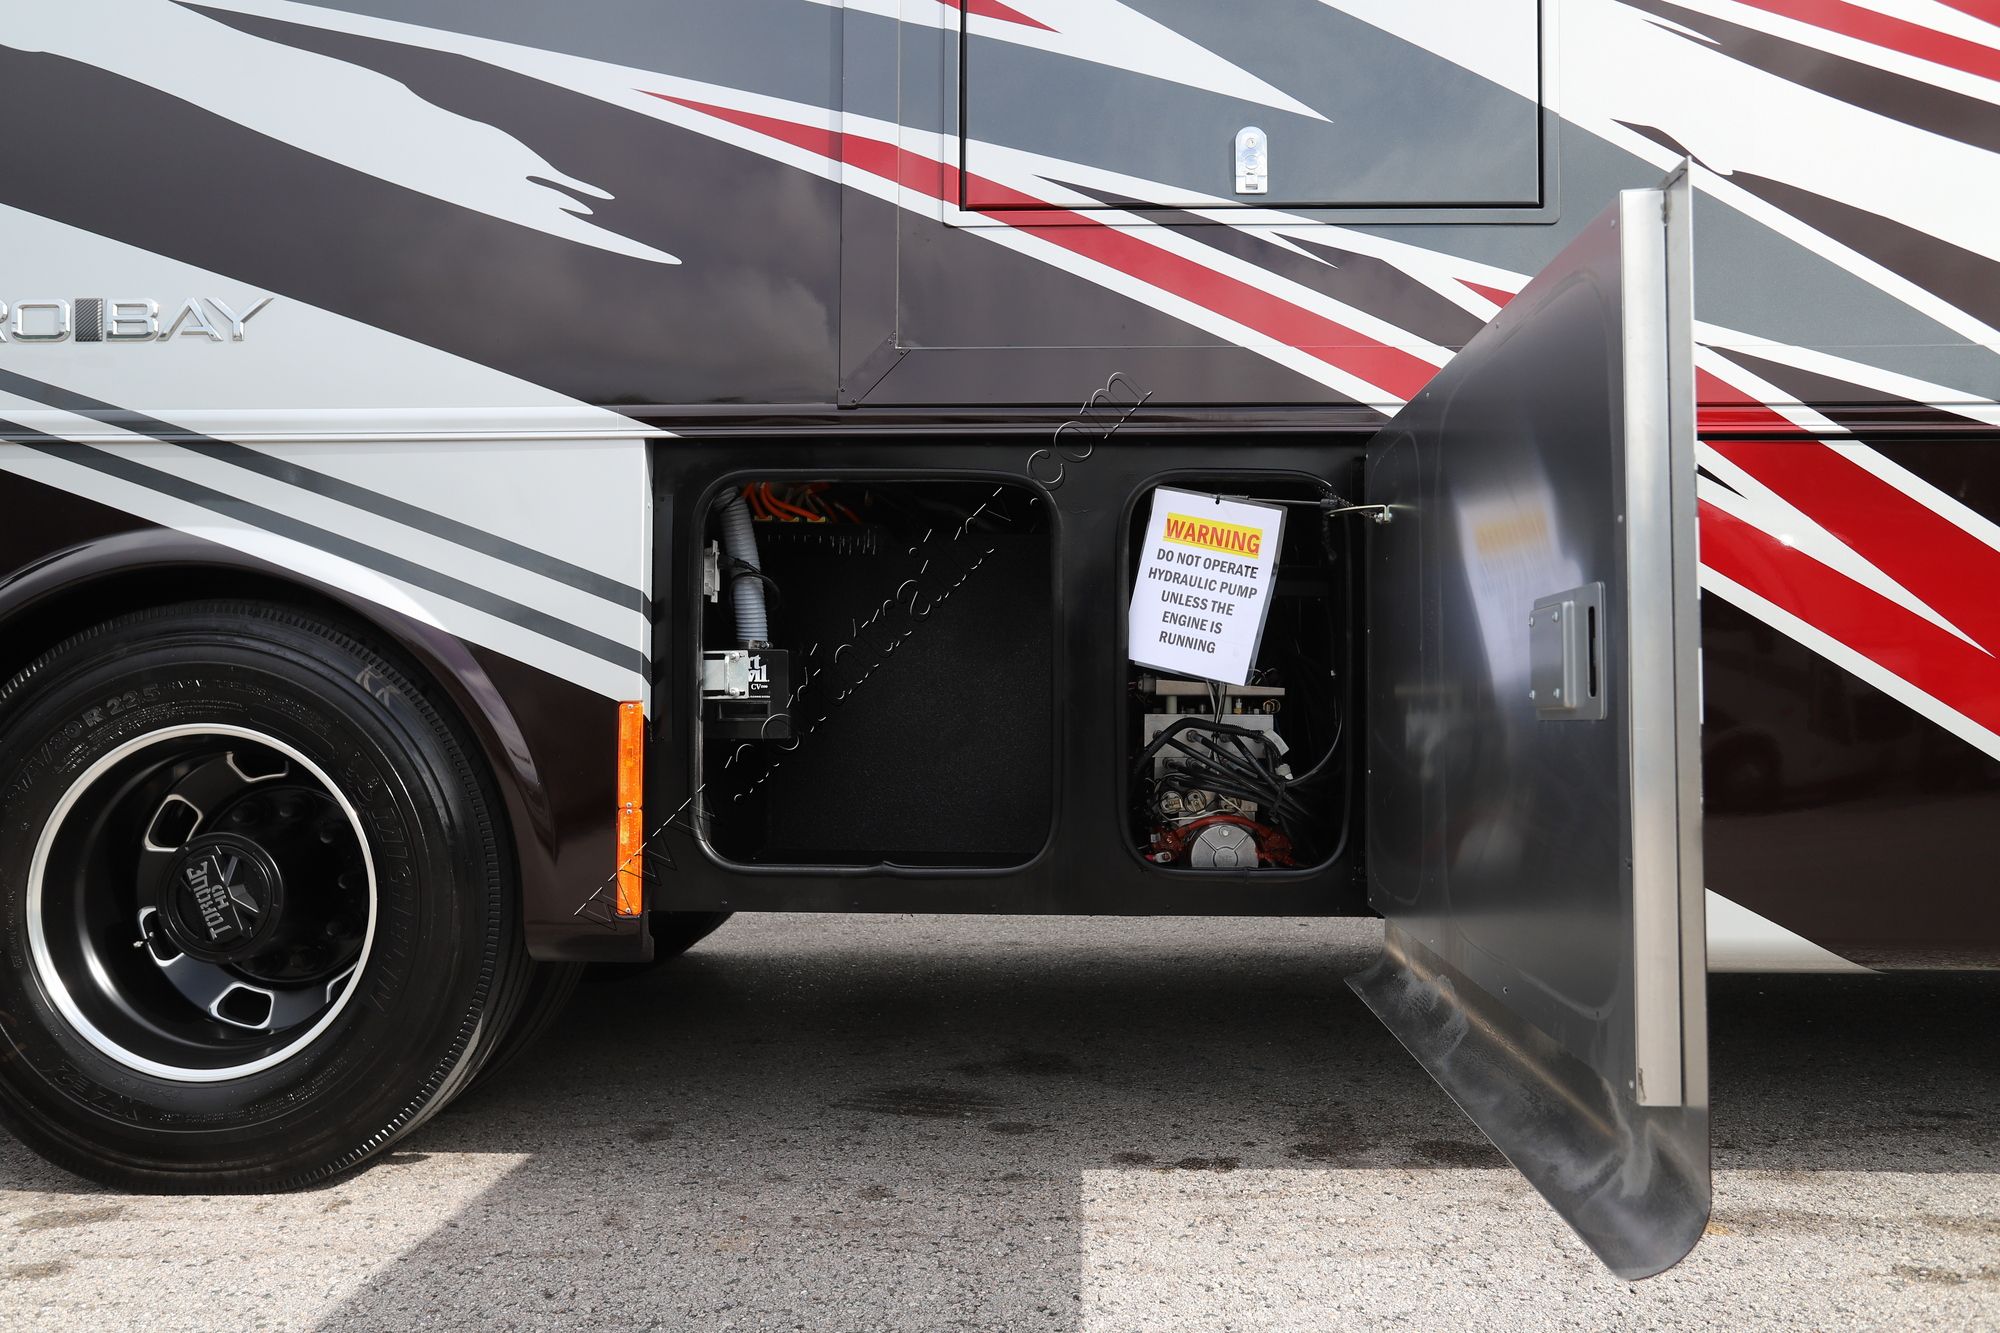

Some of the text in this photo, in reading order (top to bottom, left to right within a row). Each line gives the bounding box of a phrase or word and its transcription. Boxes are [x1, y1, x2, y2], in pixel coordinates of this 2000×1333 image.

[106, 297, 275, 342] BAY
[1166, 518, 1260, 554] WARNING
[1156, 548, 1259, 579] DO NOT OPERATE
[1148, 567, 1258, 599] HYDRAULIC PUMP
[1161, 590, 1235, 616] UNLESS THE
[1161, 611, 1223, 634] ENGINE IS
[1159, 631, 1216, 654] RUNNING
[186, 861, 232, 940] TORQUE
[211, 884, 230, 910] HD
